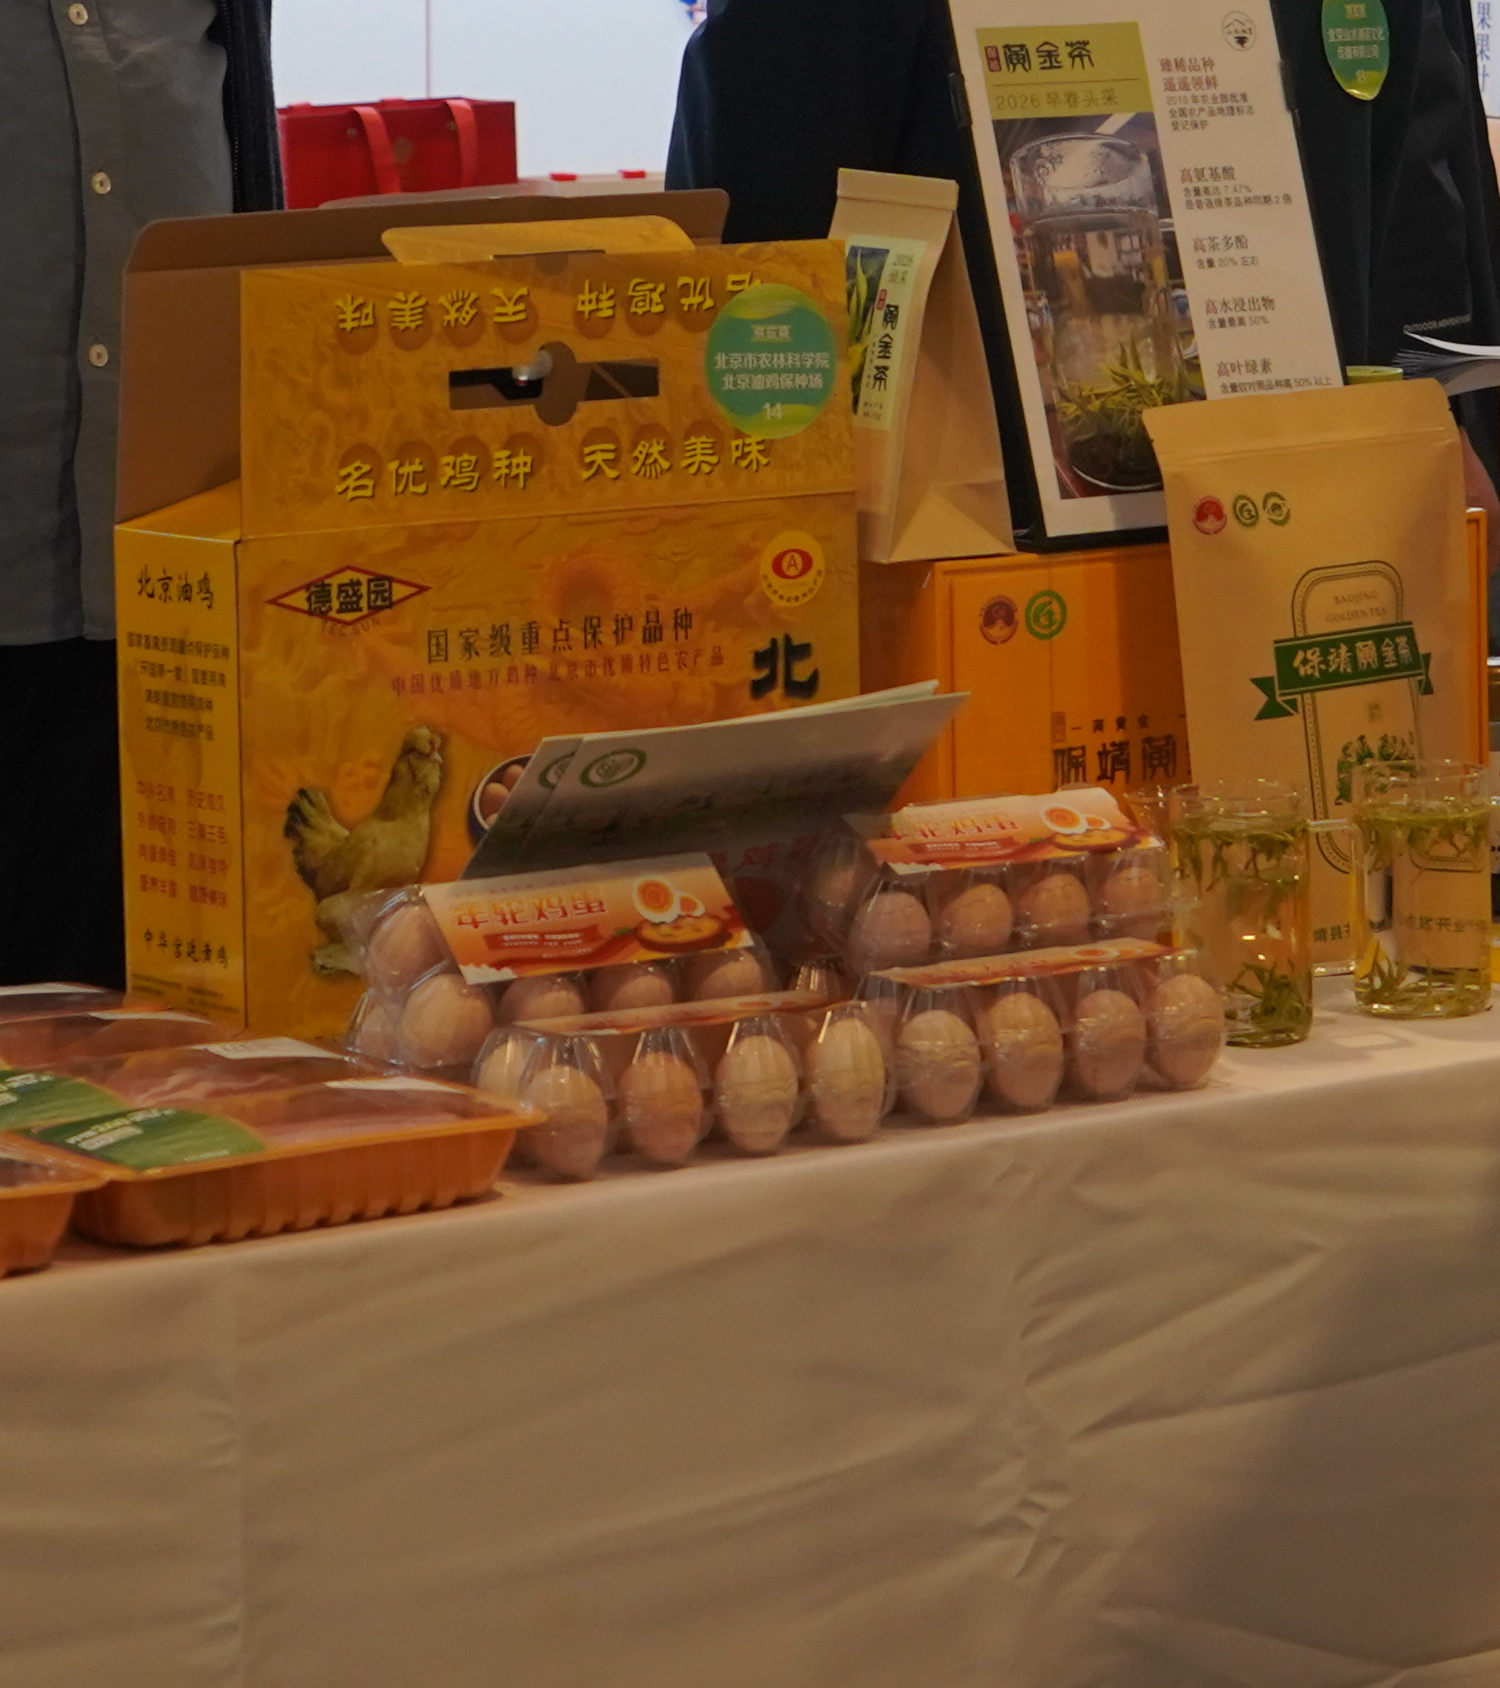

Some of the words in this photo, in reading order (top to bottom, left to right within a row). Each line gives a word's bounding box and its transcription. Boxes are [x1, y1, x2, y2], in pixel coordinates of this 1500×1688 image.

[1002, 39, 1095, 73] 黄金茶
[994, 93, 1041, 110] 2026
[1046, 87, 1118, 108] 早春头采
[1171, 119, 1209, 132] 登记保护
[1180, 166, 1236, 184] 高氨基酸
[1192, 234, 1249, 253] 高茶多酚
[1196, 258, 1216, 269] 含量
[1205, 295, 1276, 316] 高水浸出物
[1208, 316, 1247, 330] 含量最高
[714, 351, 830, 370] 北京市农林科学院
[871, 303, 900, 392] 黄金茶
[1216, 358, 1273, 378] 高叶绿素
[334, 448, 534, 501] 名优鸡种
[580, 433, 771, 480] 天然美味
[137, 564, 214, 610] 北京油鸡
[305, 575, 394, 614] 德盛园
[427, 607, 695, 664] 国家级重点保护品种
[548, 644, 725, 681] 北京市优质特色农产品
[750, 632, 821, 700] 北
[1292, 635, 1413, 679] 保靖黄金茶
